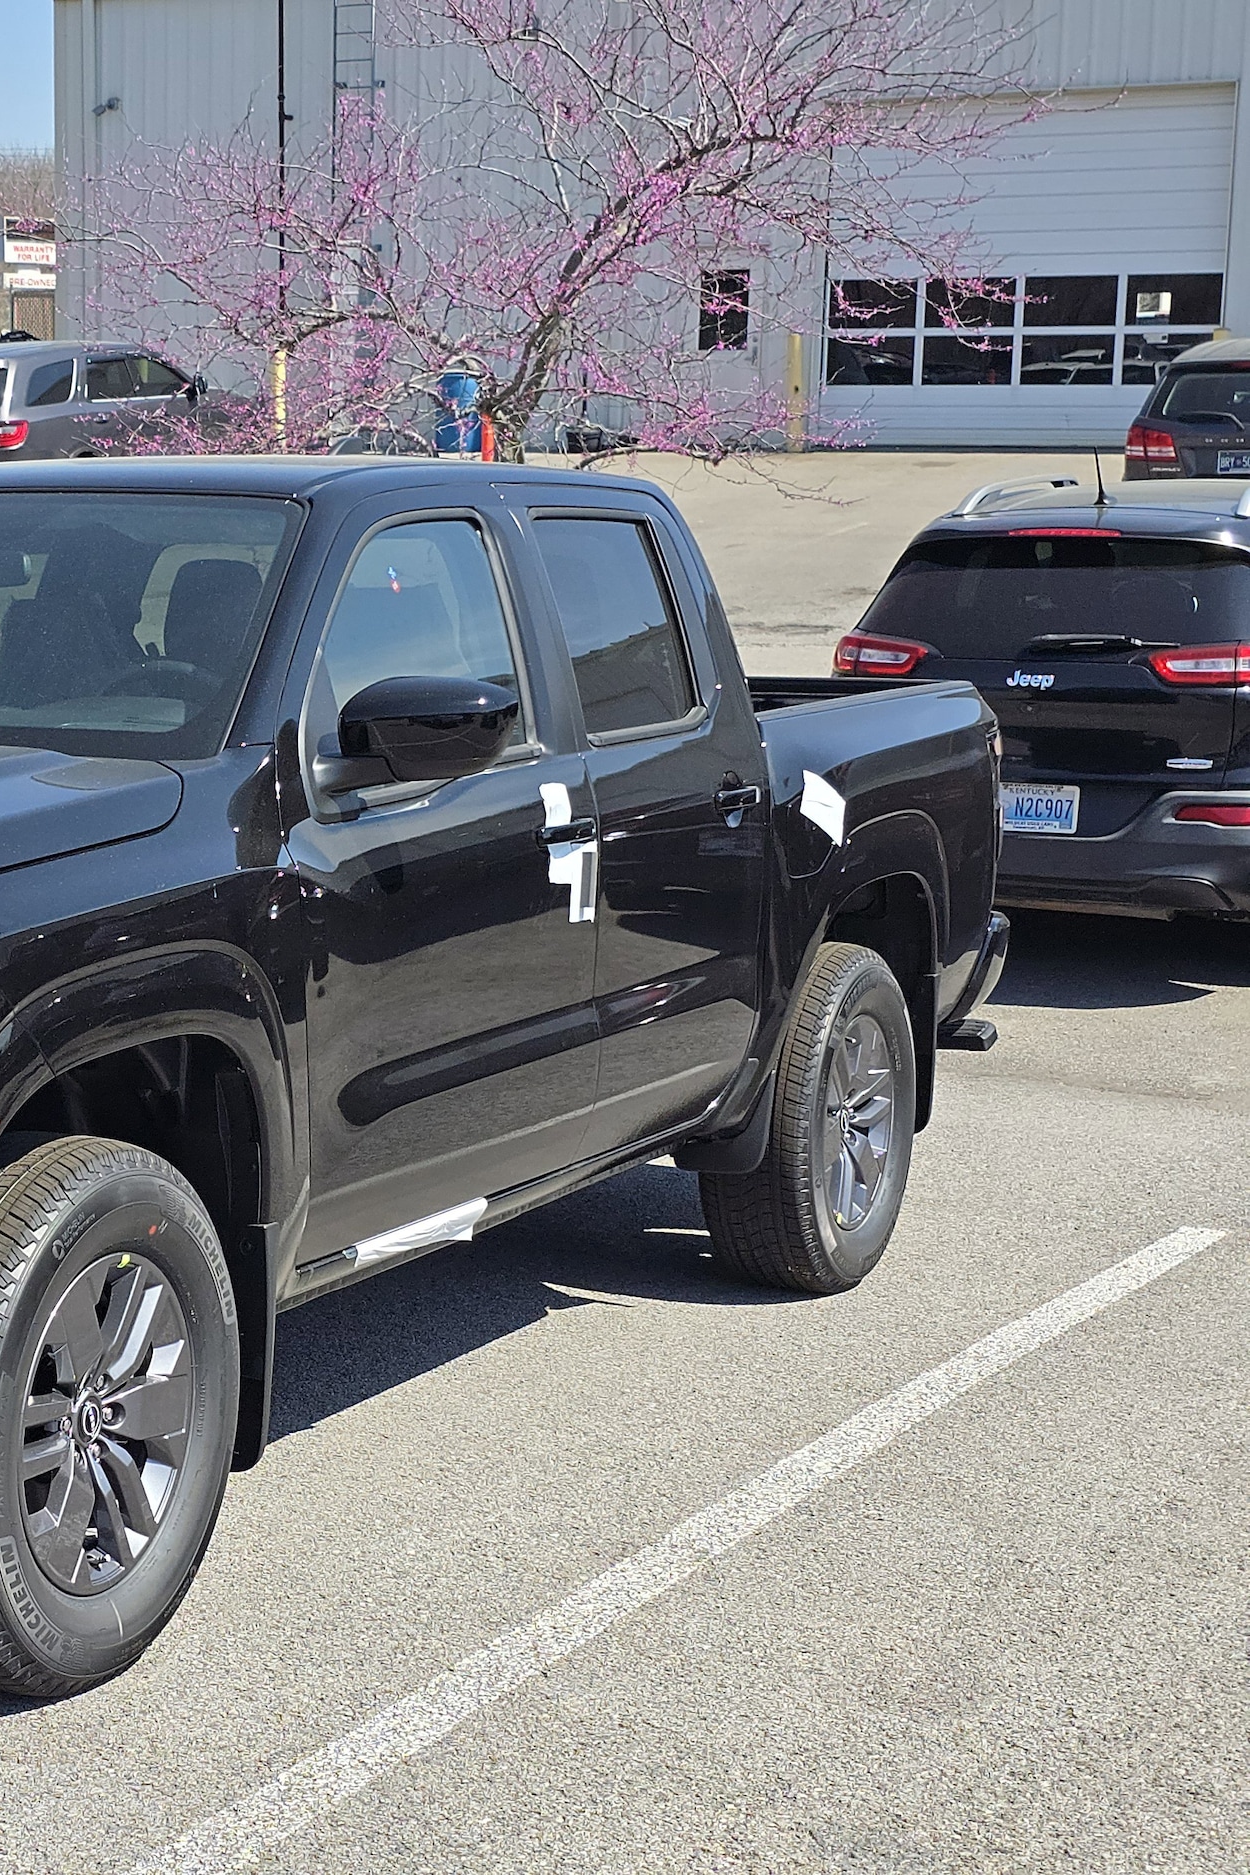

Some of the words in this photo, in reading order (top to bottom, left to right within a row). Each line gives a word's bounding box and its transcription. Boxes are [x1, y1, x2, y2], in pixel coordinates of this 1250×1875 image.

[13, 245, 54, 254] WARRANTY
[17, 253, 32, 261] FOR
[34, 254, 50, 262] LIFE
[1220, 456, 1235, 468] BRY
[1006, 669, 1055, 691] Jeep
[1009, 787, 1055, 796] KENTUCKY
[1014, 796, 1074, 820] N2C907
[188, 1212, 235, 1319] MICHELIN
[0, 1542, 60, 1652] MICHELIN
